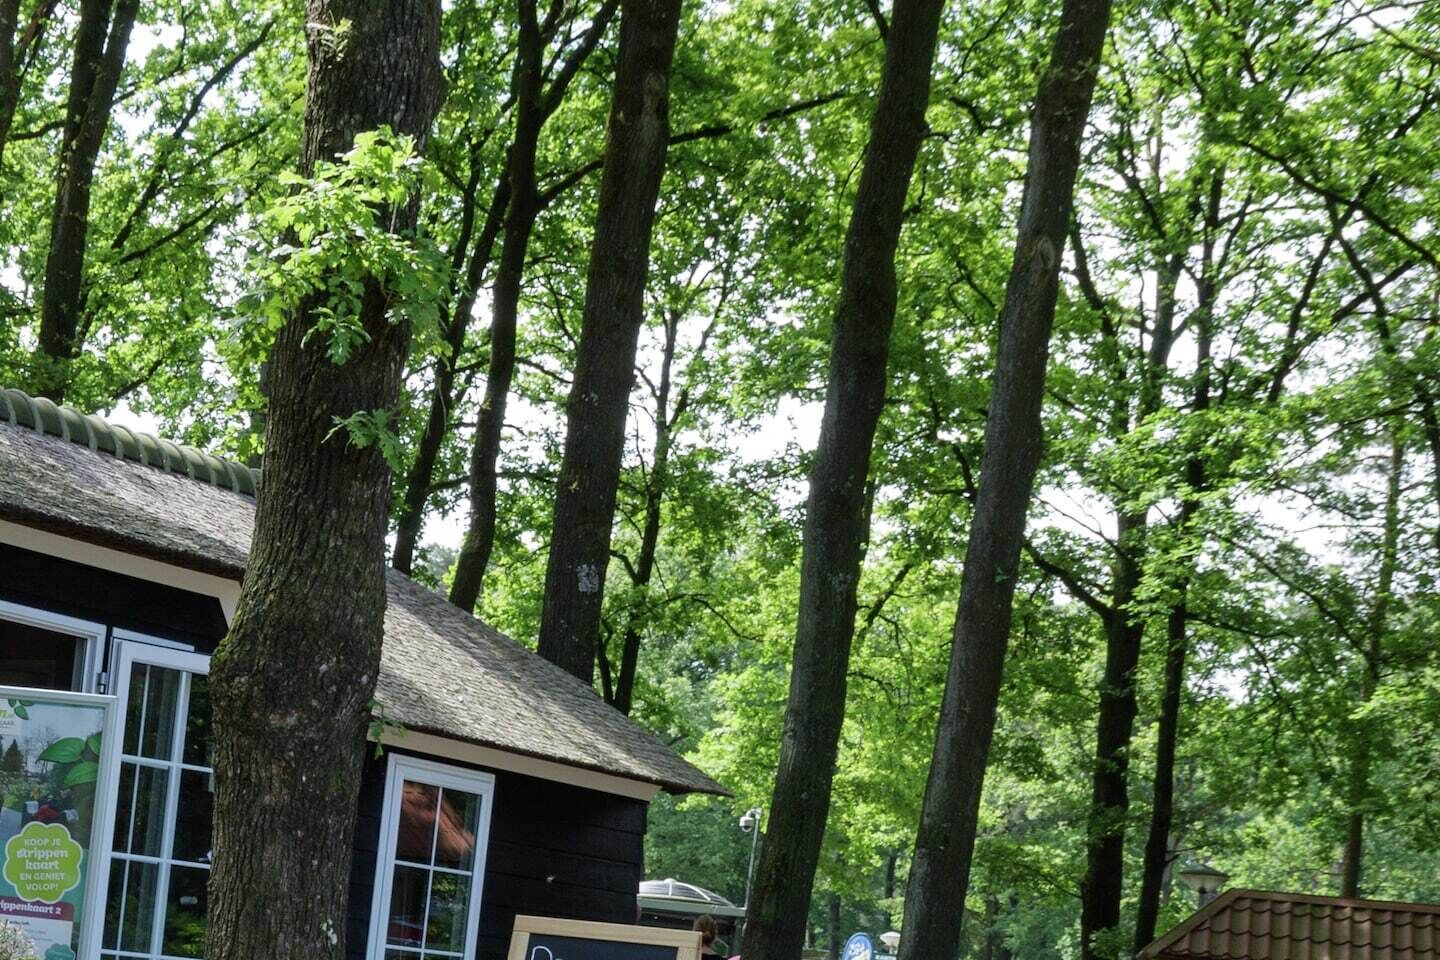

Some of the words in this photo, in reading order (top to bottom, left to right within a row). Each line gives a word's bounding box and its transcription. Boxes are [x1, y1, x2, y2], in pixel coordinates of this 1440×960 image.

[17, 848, 68, 860] strippen
[25, 860, 59, 870] kaart
[55, 907, 62, 915] 2
